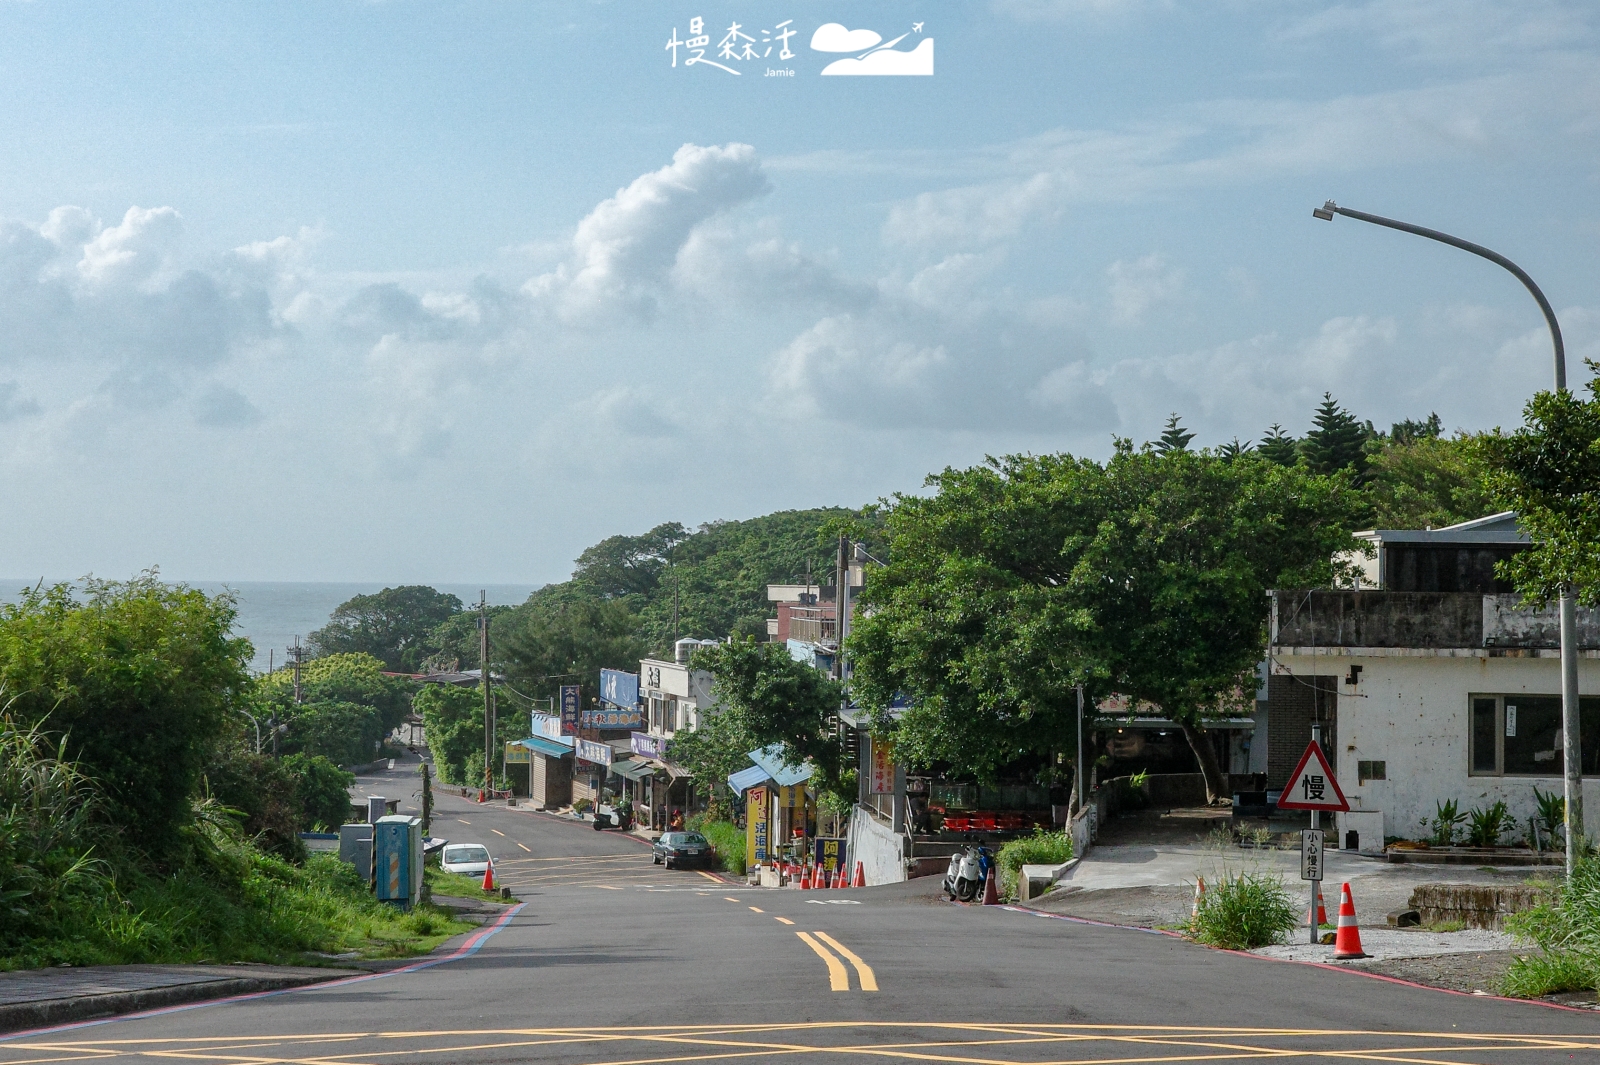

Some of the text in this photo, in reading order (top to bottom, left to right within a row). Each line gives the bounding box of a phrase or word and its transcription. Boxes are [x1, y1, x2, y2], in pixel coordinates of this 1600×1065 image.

[1302, 774, 1325, 800] 慢
[1307, 832, 1318, 877] 小心慢行
